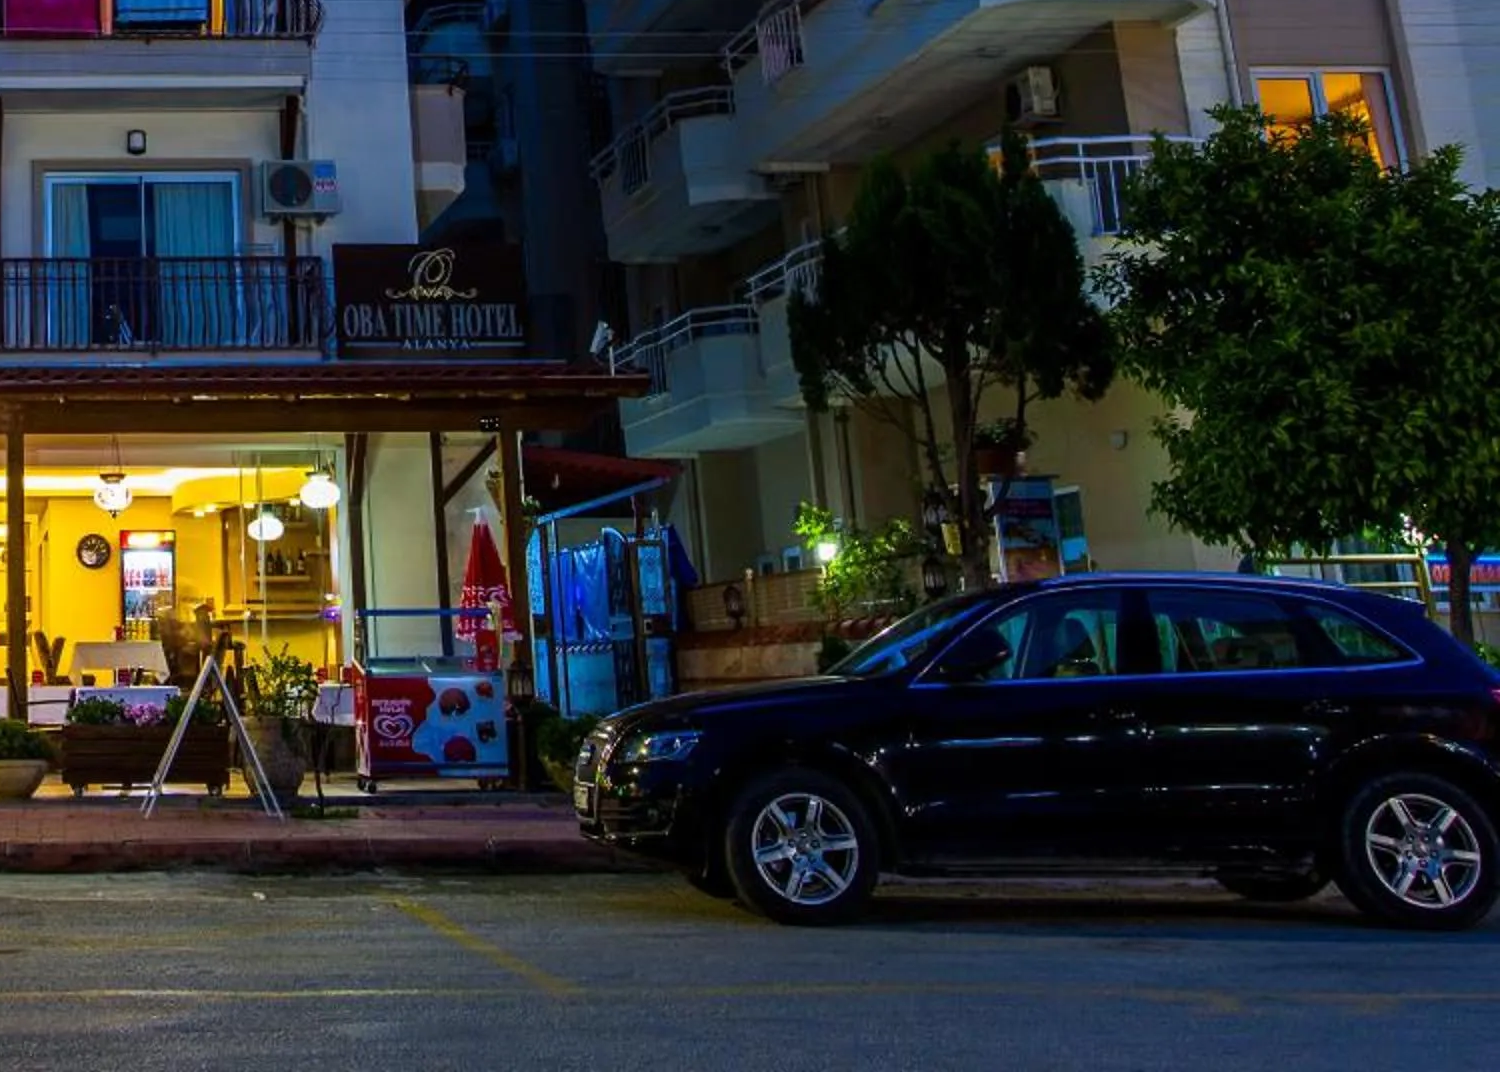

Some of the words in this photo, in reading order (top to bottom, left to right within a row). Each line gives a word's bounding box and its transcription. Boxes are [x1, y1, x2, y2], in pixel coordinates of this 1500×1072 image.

[343, 303, 388, 338] OBA
[389, 303, 446, 337] TIME
[450, 303, 523, 337] HOTEL
[402, 339, 470, 351] ALANYA
